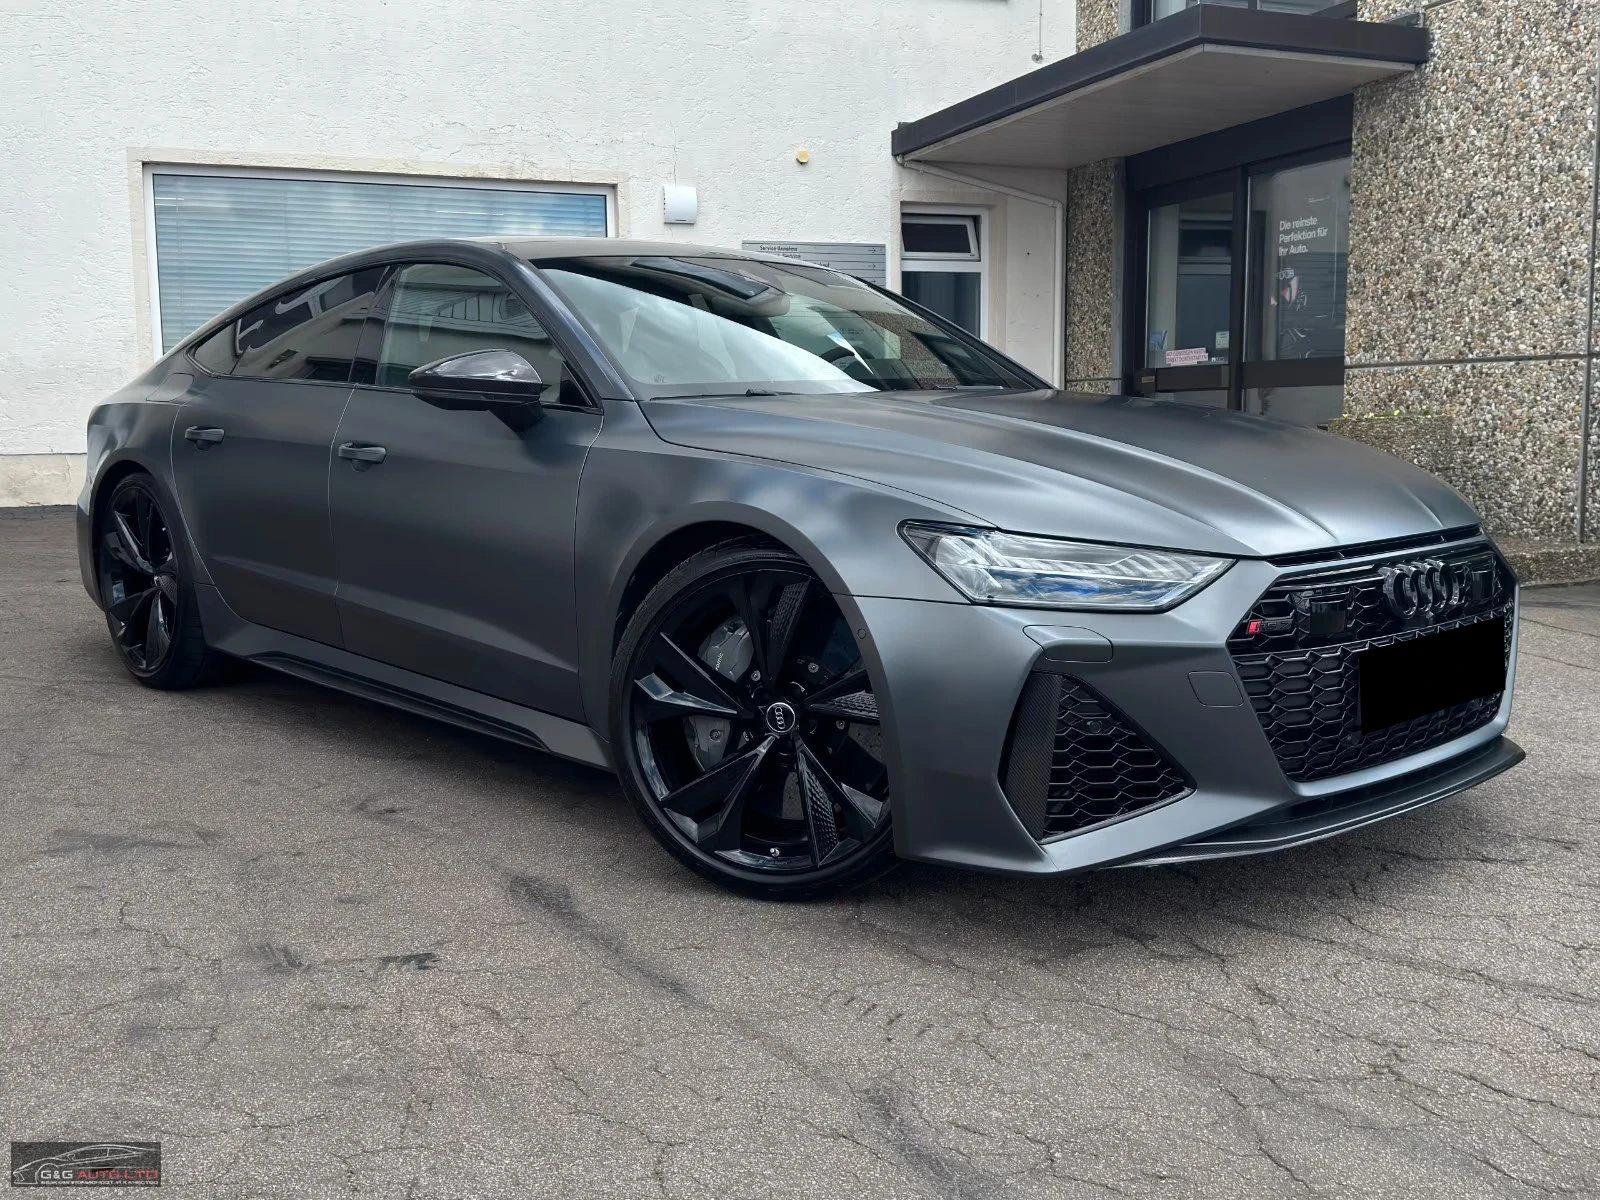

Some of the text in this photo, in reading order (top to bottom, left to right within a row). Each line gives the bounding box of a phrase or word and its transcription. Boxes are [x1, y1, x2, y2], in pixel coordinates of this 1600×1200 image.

[1280, 216, 1318, 231] Die reinste
[1279, 227, 1328, 243] Perfektion für
[1279, 244, 1309, 257] Ihr Auto.
